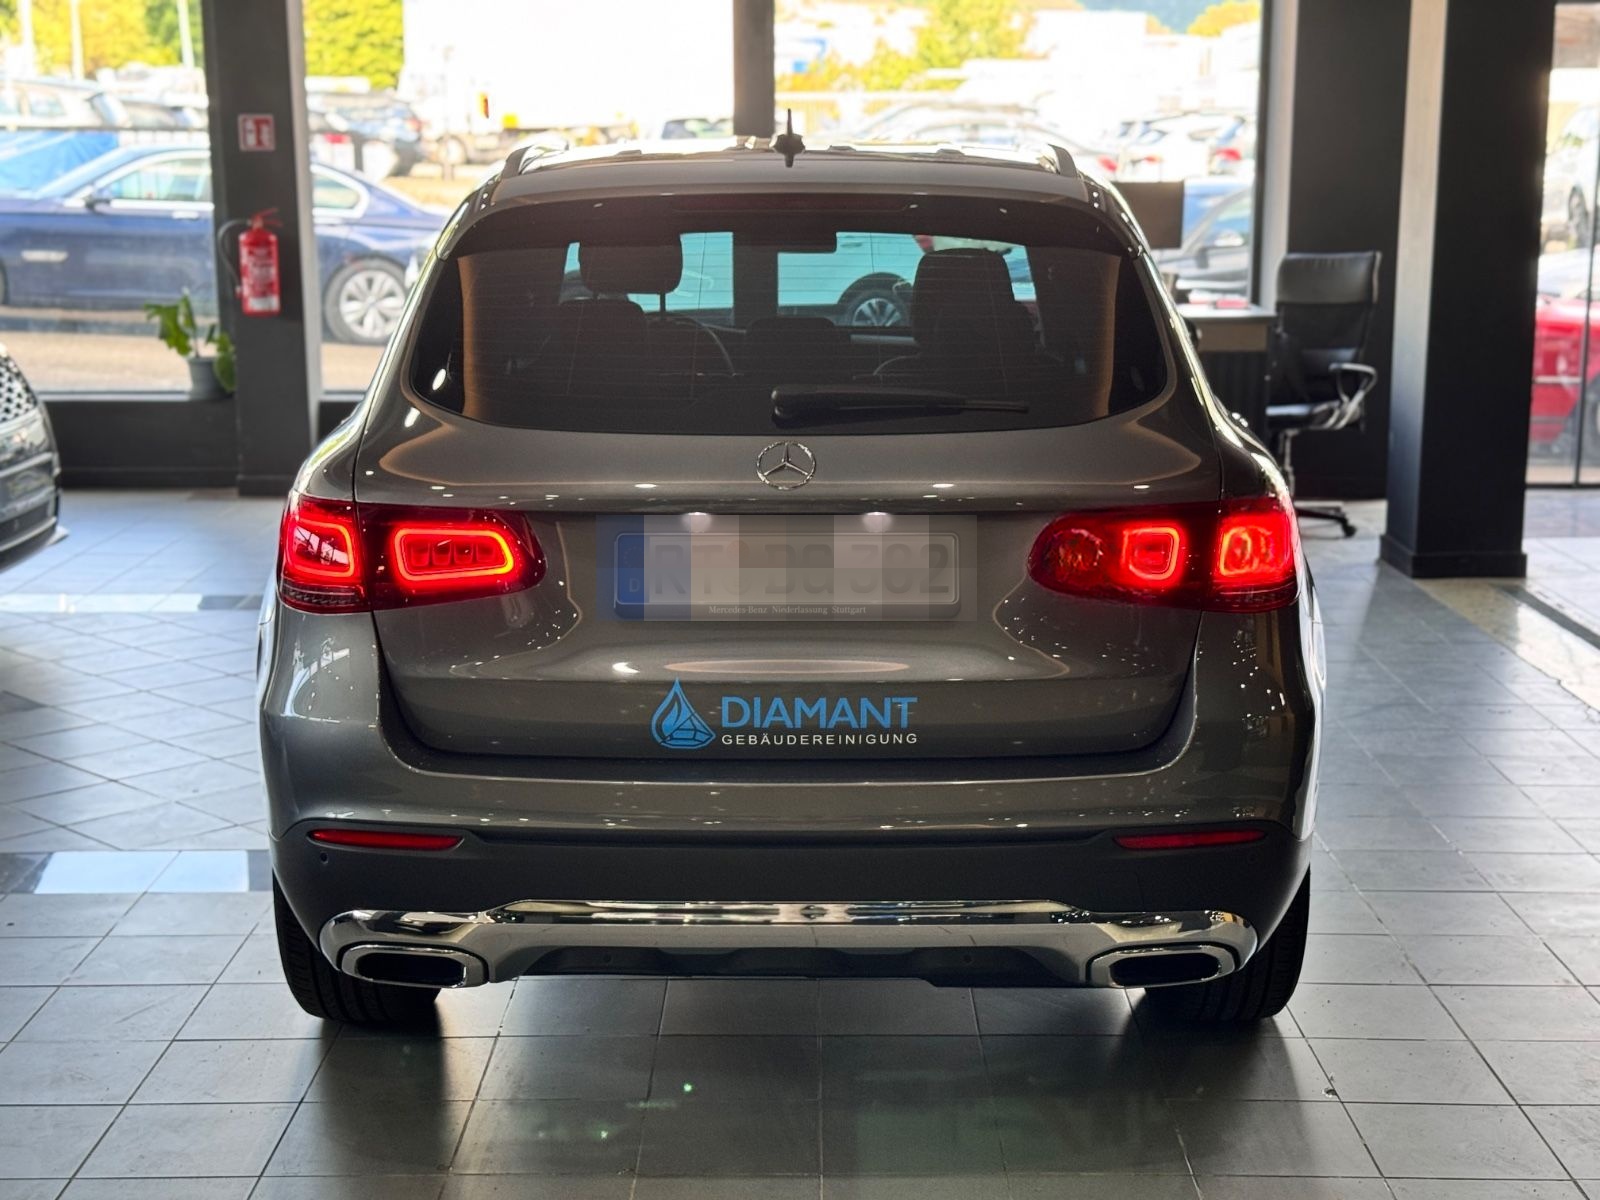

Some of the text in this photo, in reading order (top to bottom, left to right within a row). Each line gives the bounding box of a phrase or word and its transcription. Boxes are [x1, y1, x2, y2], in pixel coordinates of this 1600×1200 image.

[629, 578, 641, 593] D
[708, 605, 867, 615] Mercedes-Benz Niederlassung Stuttgart
[721, 696, 918, 729] DIAMANT
[721, 732, 918, 746] GEBÄUDEREINIGUNG
